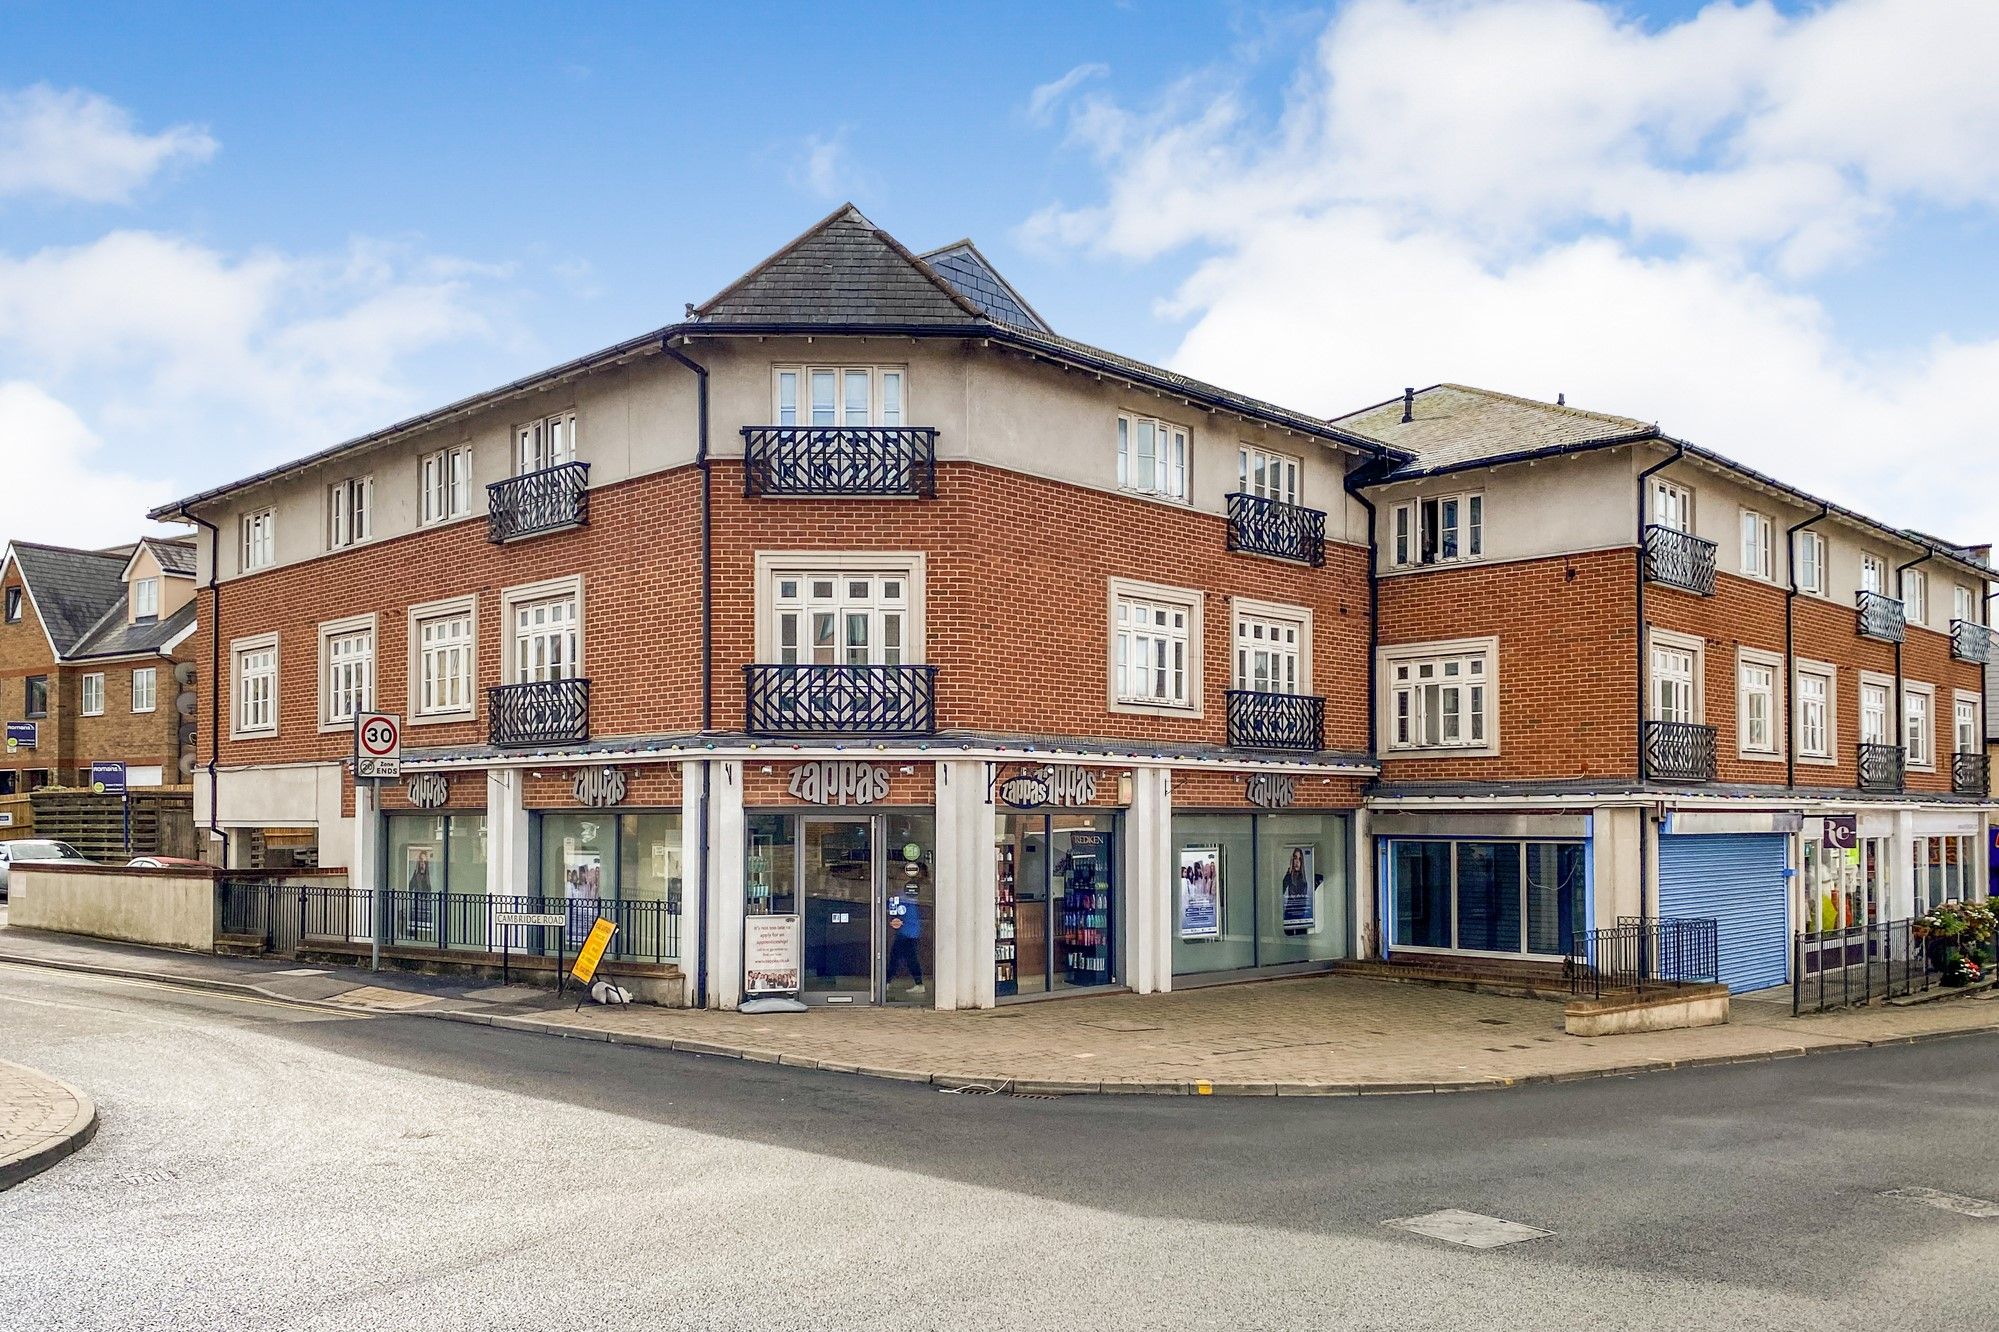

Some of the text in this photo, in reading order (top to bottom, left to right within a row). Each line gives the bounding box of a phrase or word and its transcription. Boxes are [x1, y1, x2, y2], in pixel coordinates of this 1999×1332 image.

[367, 728, 392, 743] 30
[376, 767, 398, 775] ENDS
[573, 765, 625, 806] zappas
[788, 760, 890, 806] zappas
[1002, 779, 1047, 805] zappas
[1247, 772, 1295, 808] zappas
[1075, 835, 1104, 844] REDKEN
[497, 914, 564, 925] CAMBRIDGE ROAD
